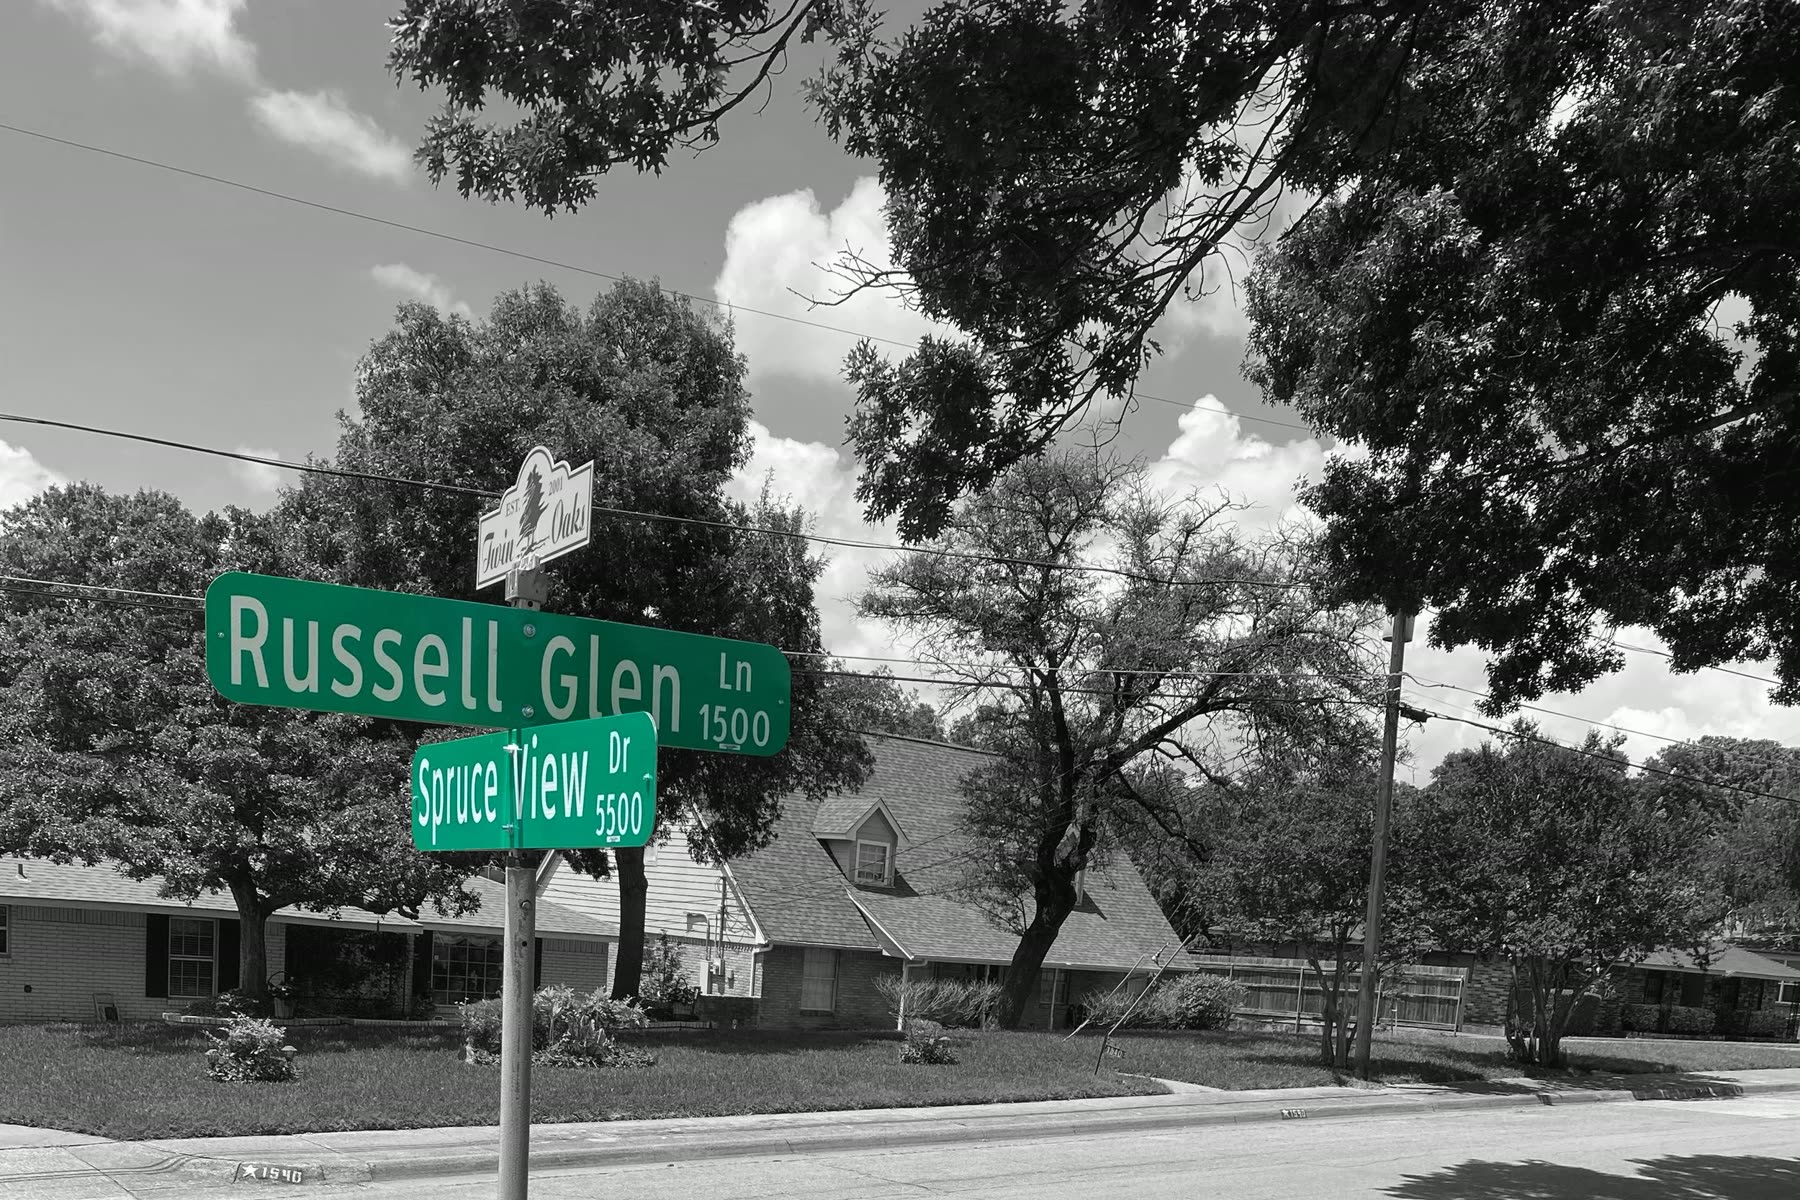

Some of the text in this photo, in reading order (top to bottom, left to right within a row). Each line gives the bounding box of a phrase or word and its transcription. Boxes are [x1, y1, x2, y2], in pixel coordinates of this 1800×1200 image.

[505, 476, 563, 517] EST. 2001
[482, 492, 586, 574] Twin Oaks
[229, 594, 681, 733] Russell Glen
[719, 652, 752, 693] Ln
[699, 703, 770, 747] 1500
[609, 731, 631, 774] Dr
[418, 733, 589, 845] Spruce View
[595, 791, 642, 836] 5500
[262, 1166, 302, 1183] 1540
